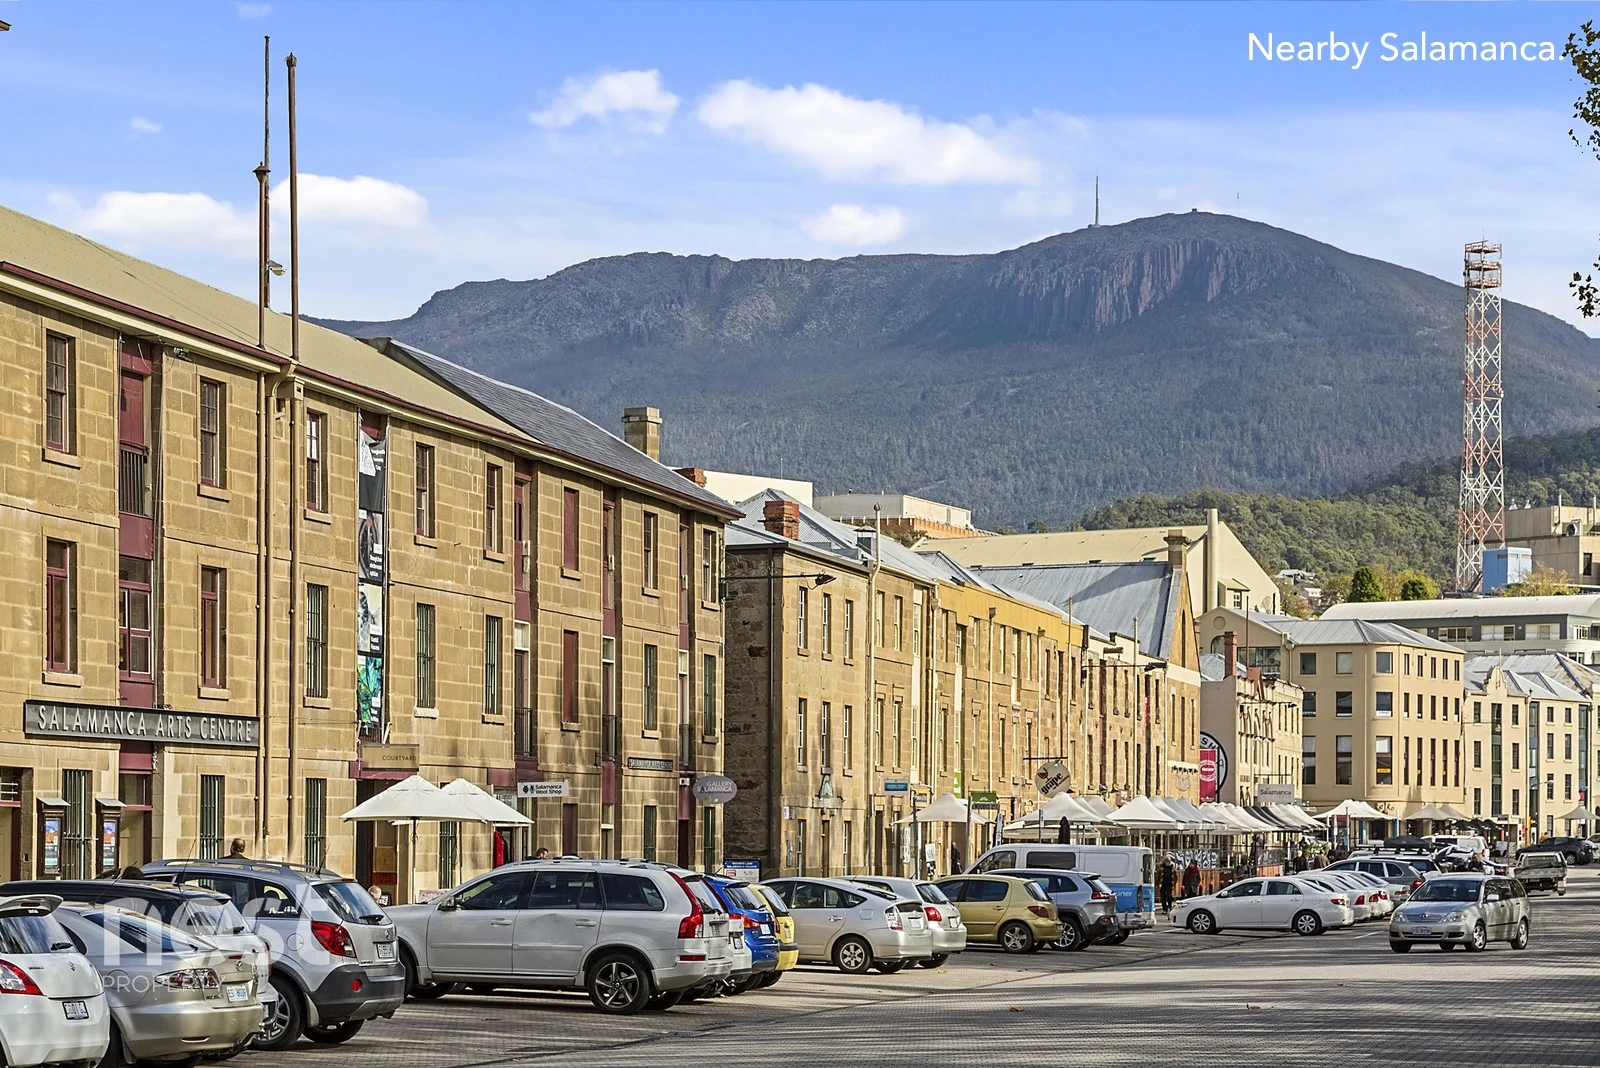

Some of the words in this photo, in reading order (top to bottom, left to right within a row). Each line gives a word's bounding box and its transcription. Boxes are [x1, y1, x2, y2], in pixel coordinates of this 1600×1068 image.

[38, 705, 147, 736] SALAMANCA
[155, 714, 192, 739] ARTS
[200, 718, 252, 742] CENTRE
[1260, 788, 1292, 796] Salamanca
